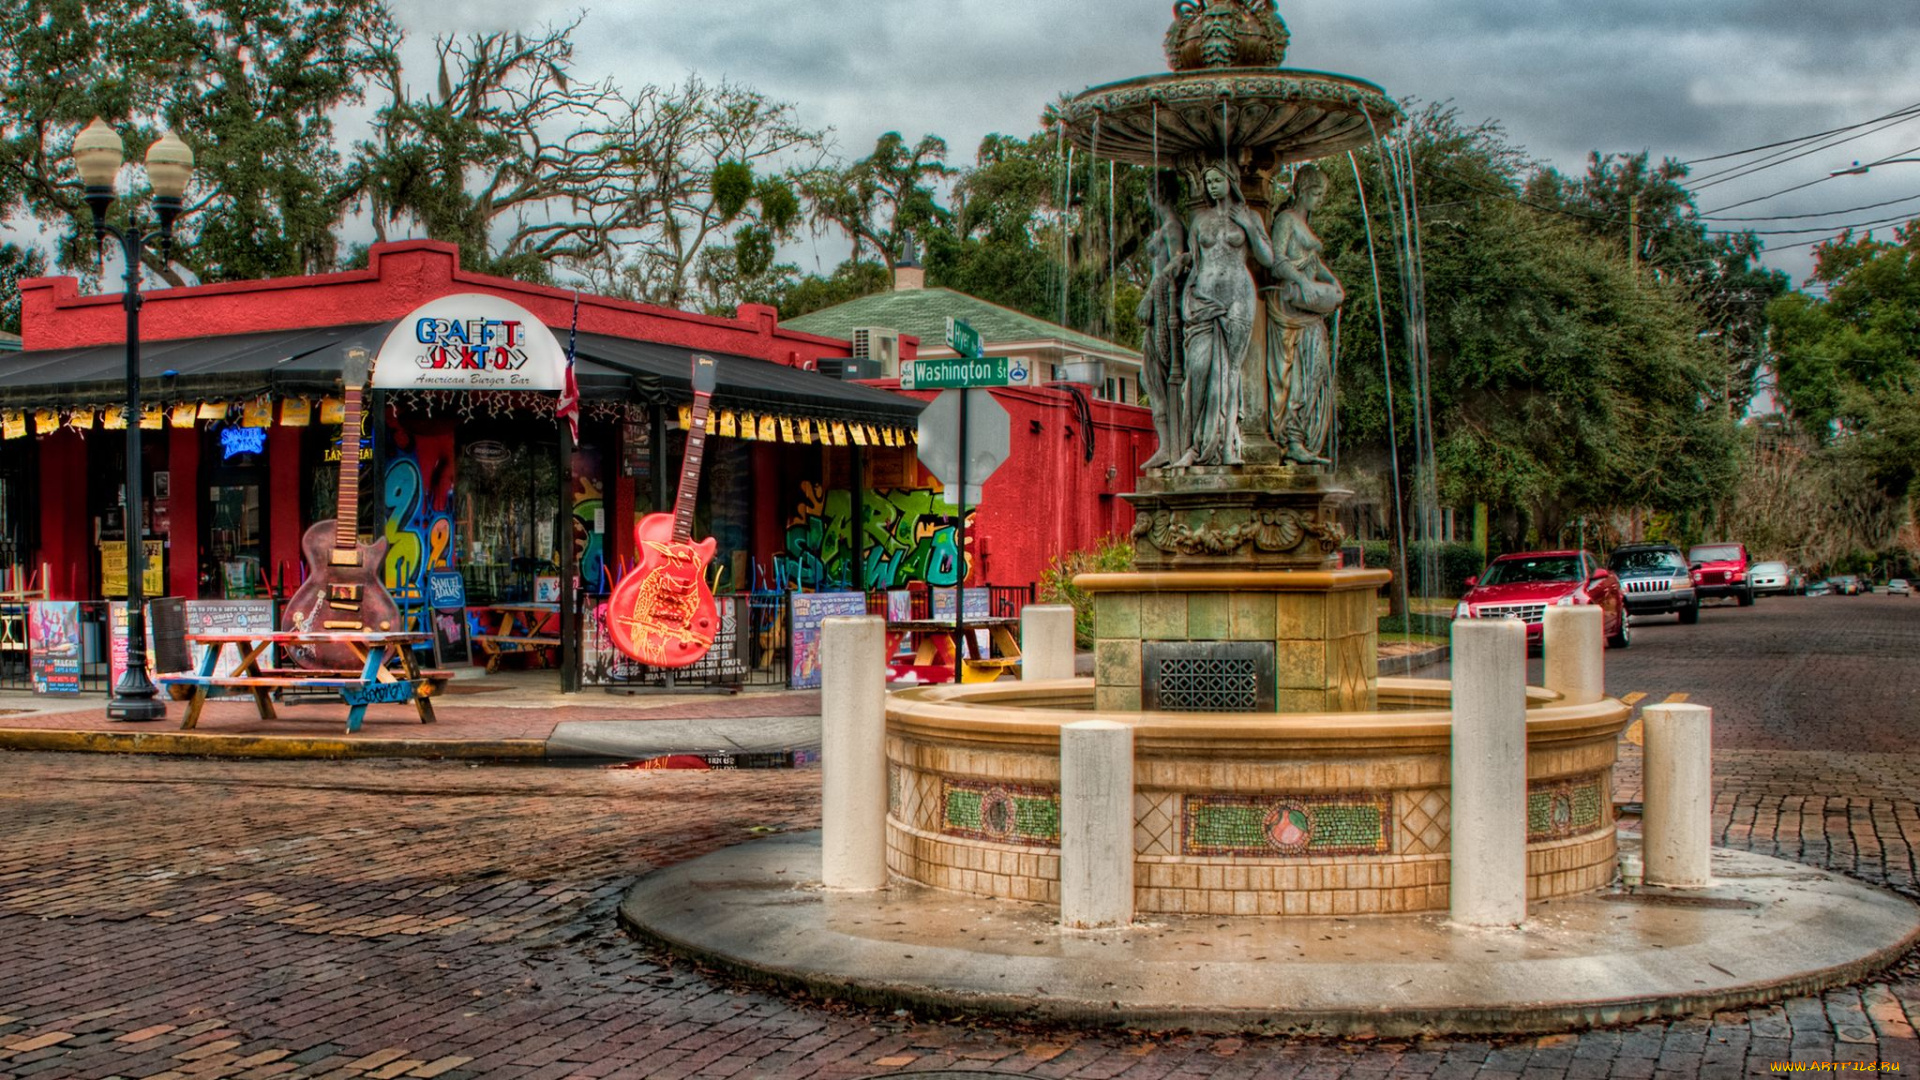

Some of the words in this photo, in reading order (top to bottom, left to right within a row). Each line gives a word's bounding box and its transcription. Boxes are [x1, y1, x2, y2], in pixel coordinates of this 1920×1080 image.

[416, 317, 526, 348] GRAFFITI
[954, 323, 970, 352] Hyer
[415, 345, 528, 373] JUNKTION
[414, 373, 465, 384] American
[470, 373, 505, 388] Burger
[510, 374, 530, 385] Bar
[915, 361, 991, 385] Washington
[997, 366, 1007, 379] St
[431, 576, 462, 590] SAMUEL
[434, 585, 461, 601] ADAMS
